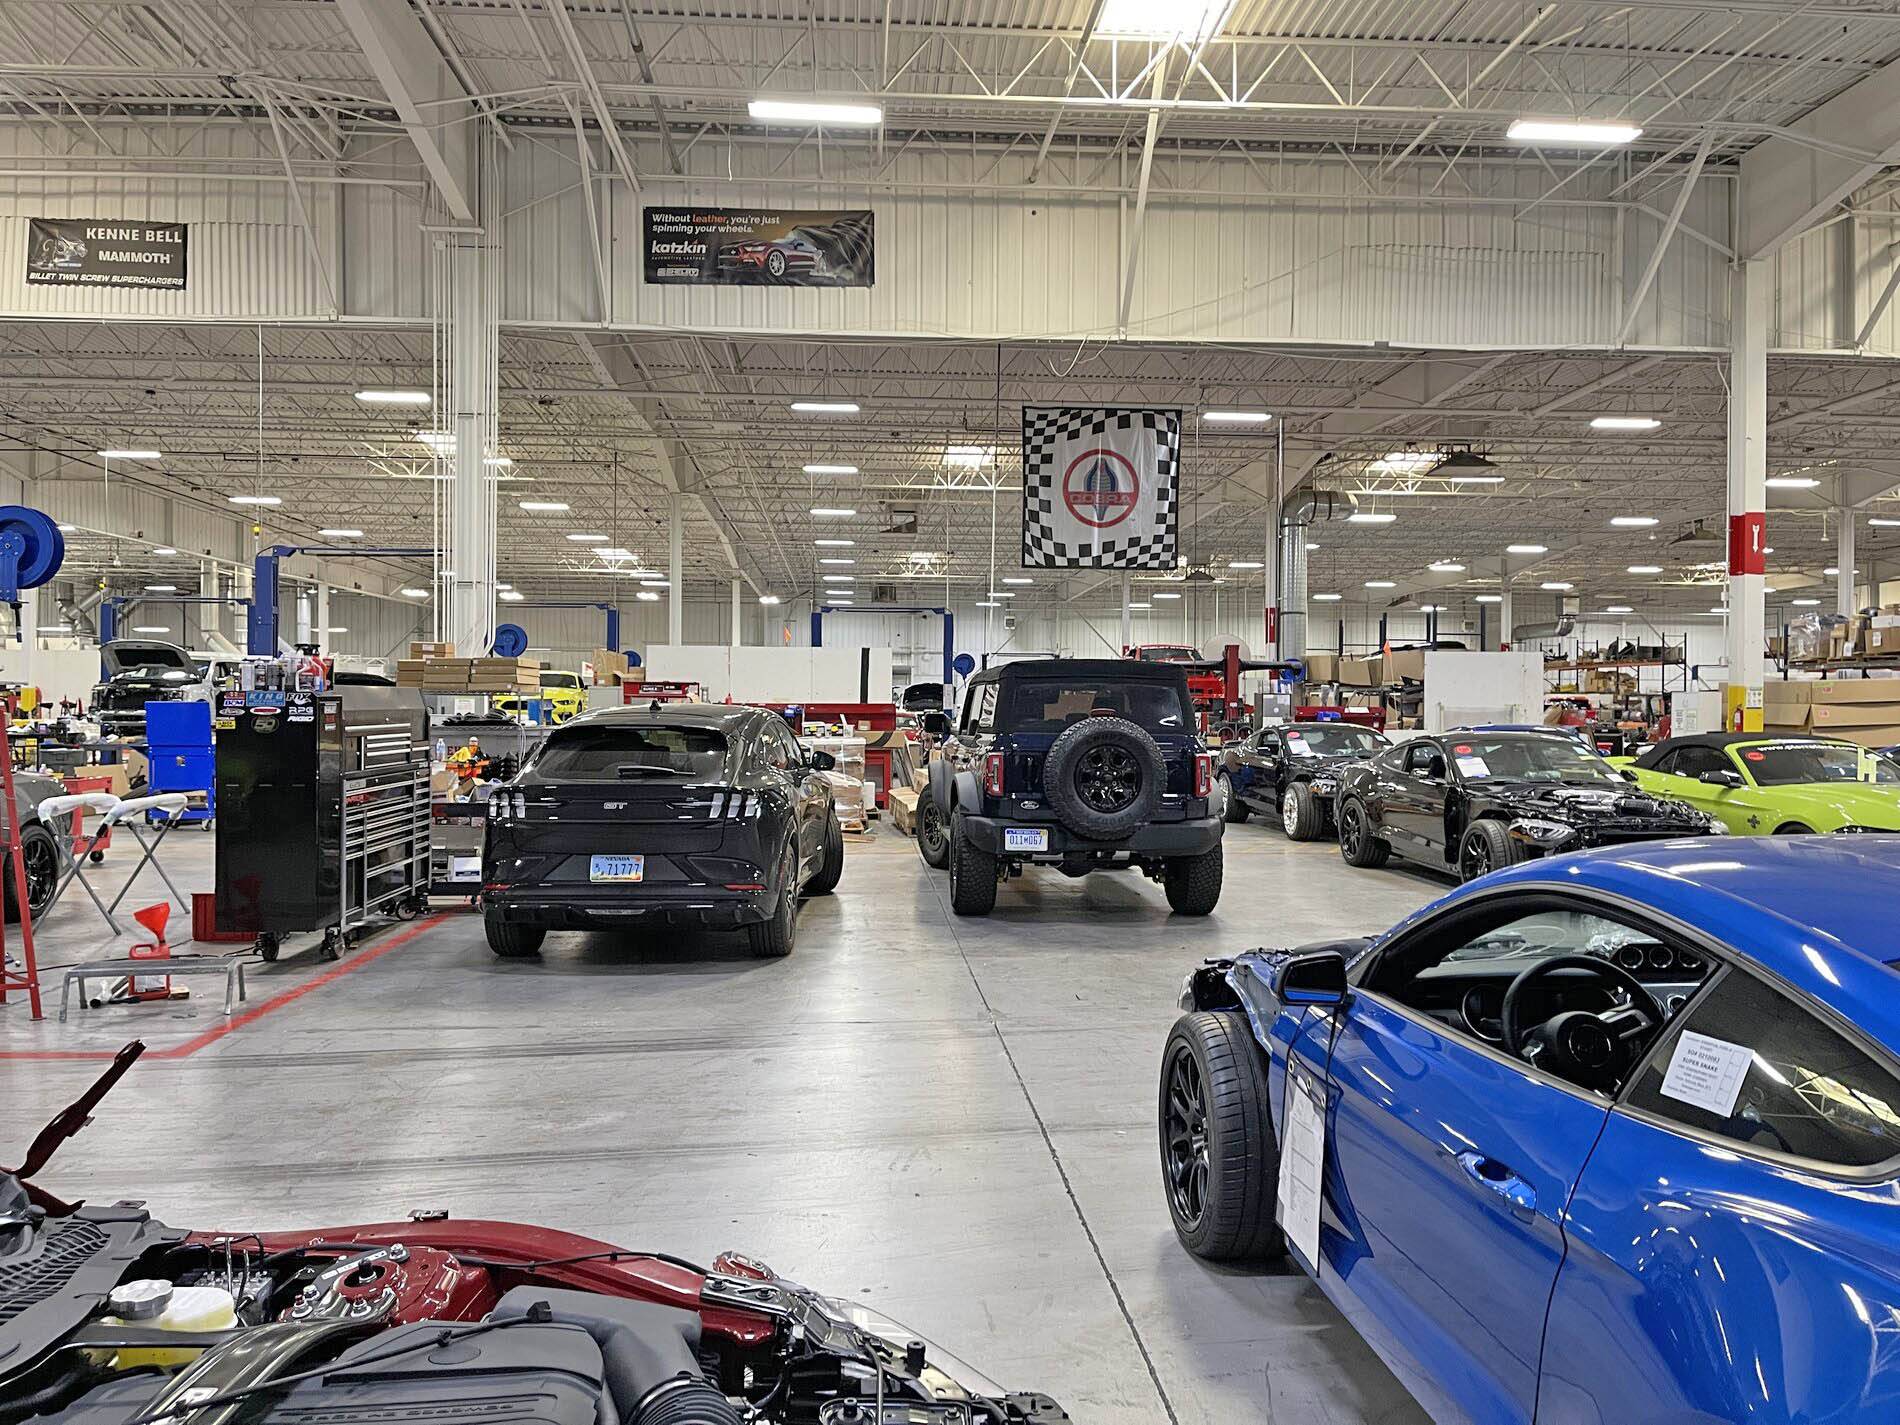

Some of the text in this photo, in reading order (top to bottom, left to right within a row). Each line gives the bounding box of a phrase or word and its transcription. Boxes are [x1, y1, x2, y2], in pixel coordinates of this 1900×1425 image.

[652, 213, 780, 226] Without leather, you're just
[86, 227, 183, 243] KENNE BELL
[652, 223, 754, 235] spinning your wheels.
[651, 239, 707, 254] katzkin
[98, 250, 171, 264] MAMMOTH
[28, 272, 184, 286] BILLET TWIN SCREW SUPERCHARGERS
[1069, 493, 1132, 505] COBRA
[288, 706, 314, 714] RPG
[603, 802, 628, 810] GT
